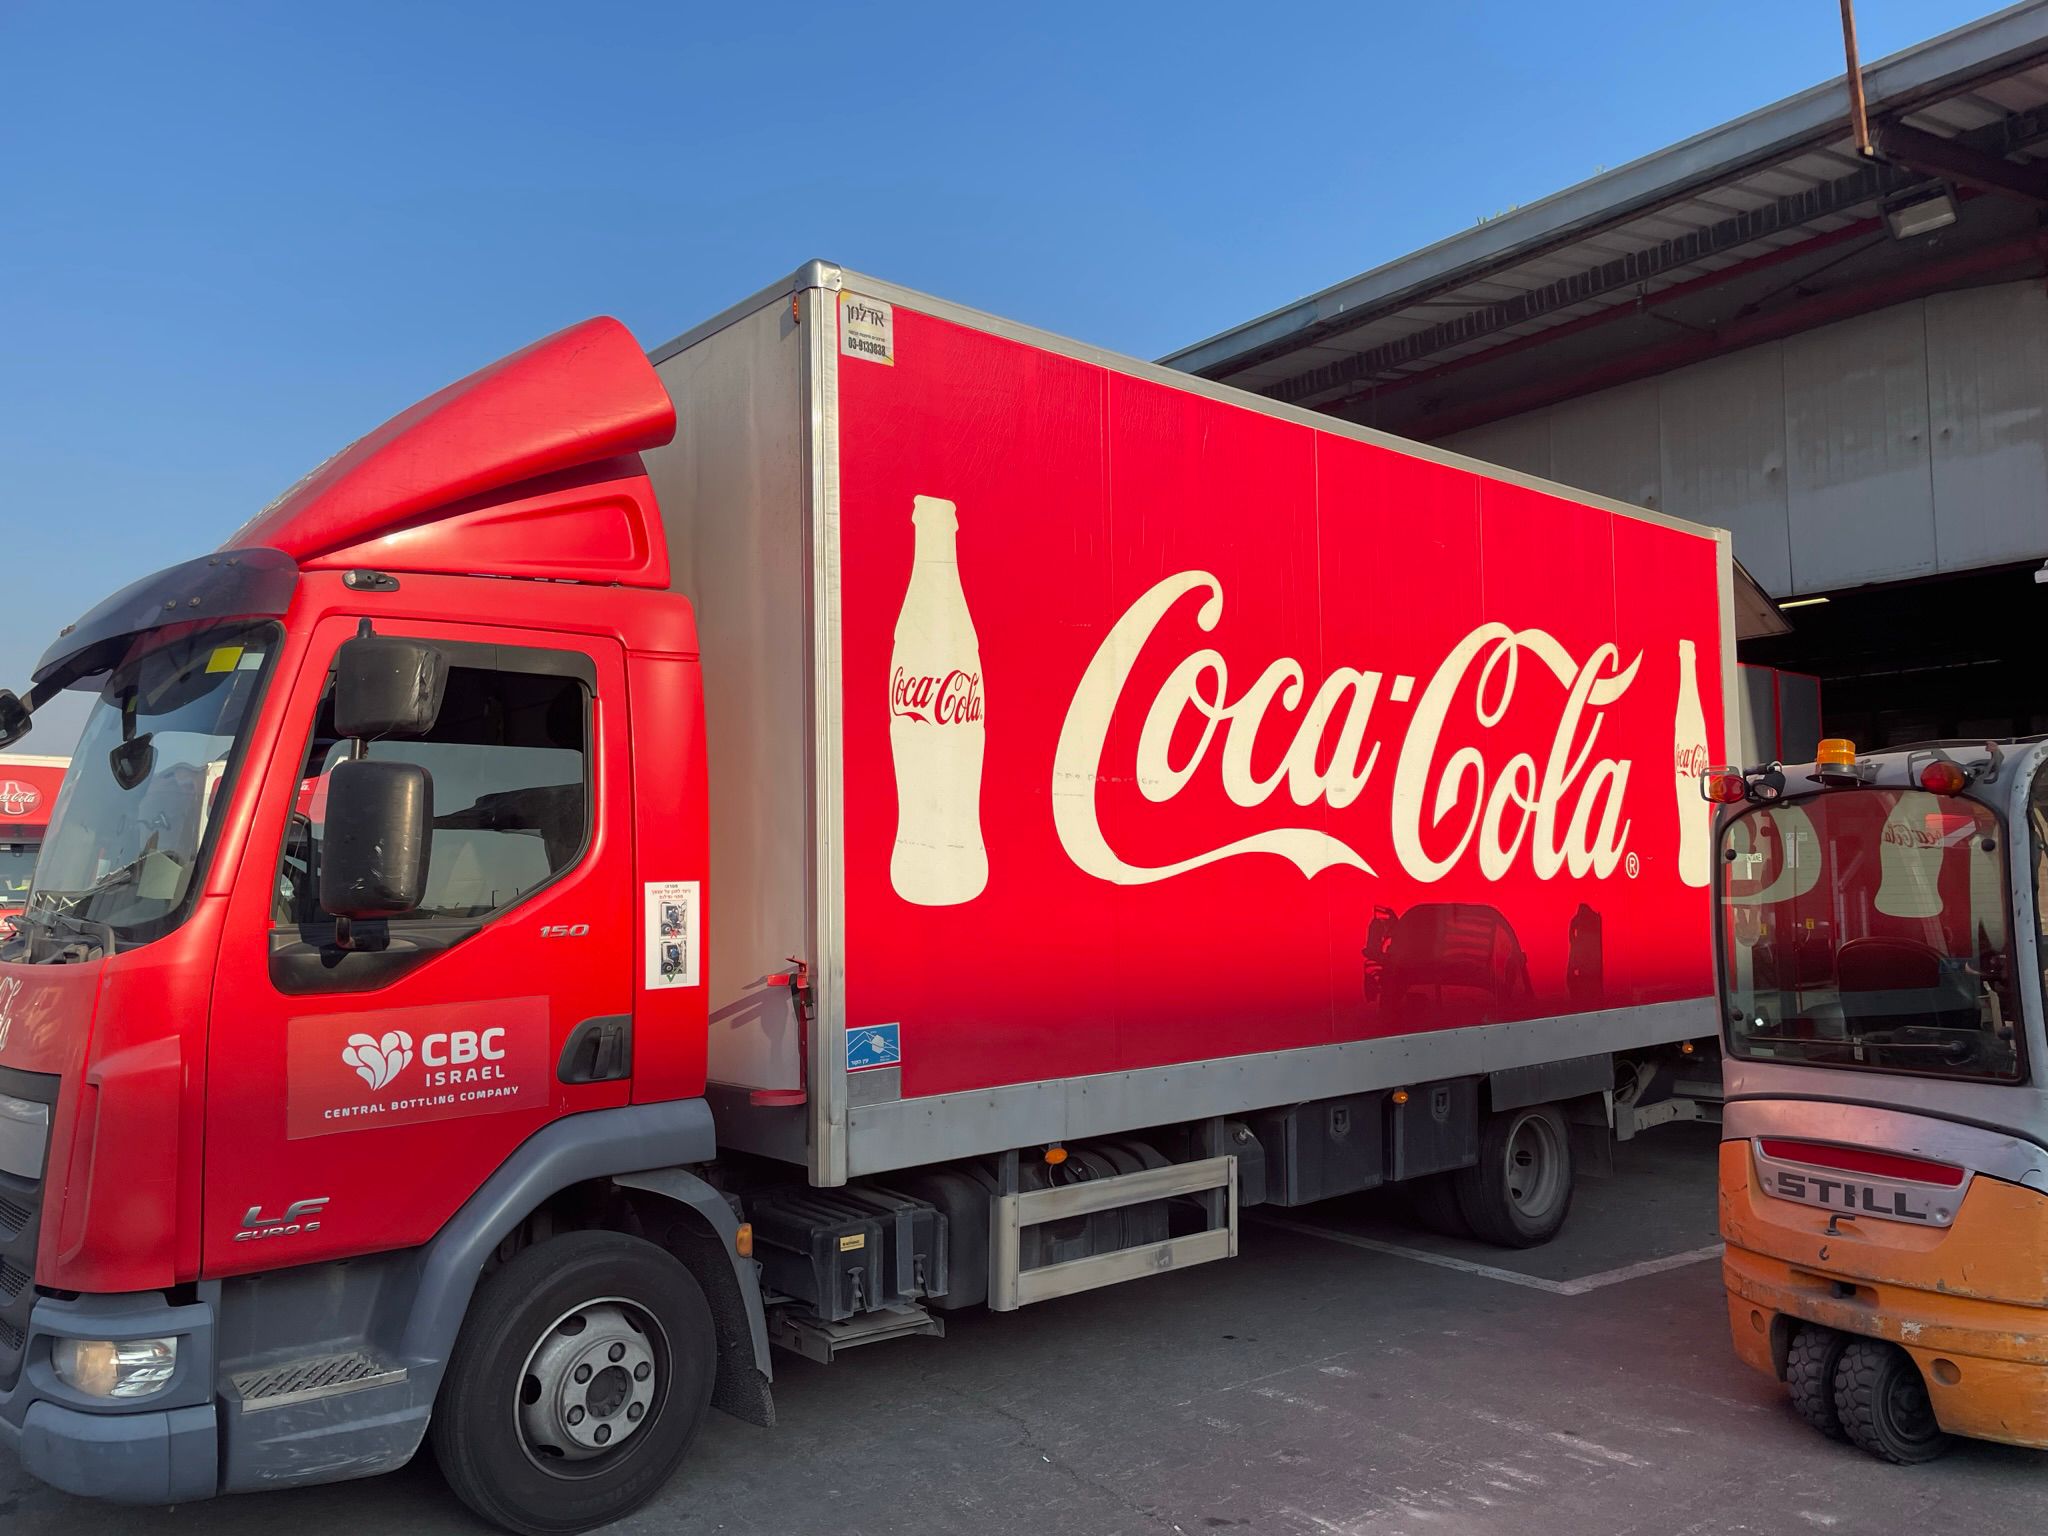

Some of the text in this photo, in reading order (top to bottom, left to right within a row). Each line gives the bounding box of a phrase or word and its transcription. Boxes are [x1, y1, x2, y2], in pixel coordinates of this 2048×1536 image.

[891, 666, 981, 726] Coca-Cola
[1051, 569, 1643, 886] Coca-Cola
[540, 924, 590, 938] 150
[421, 1027, 505, 1067] CBC
[425, 1065, 505, 1087] ISRAEL
[324, 1086, 519, 1119] CENTRAL BOTTLING COMPANY
[243, 1196, 331, 1228] LF
[1778, 1171, 1927, 1220] STILL
[234, 1225, 300, 1242] EURO
